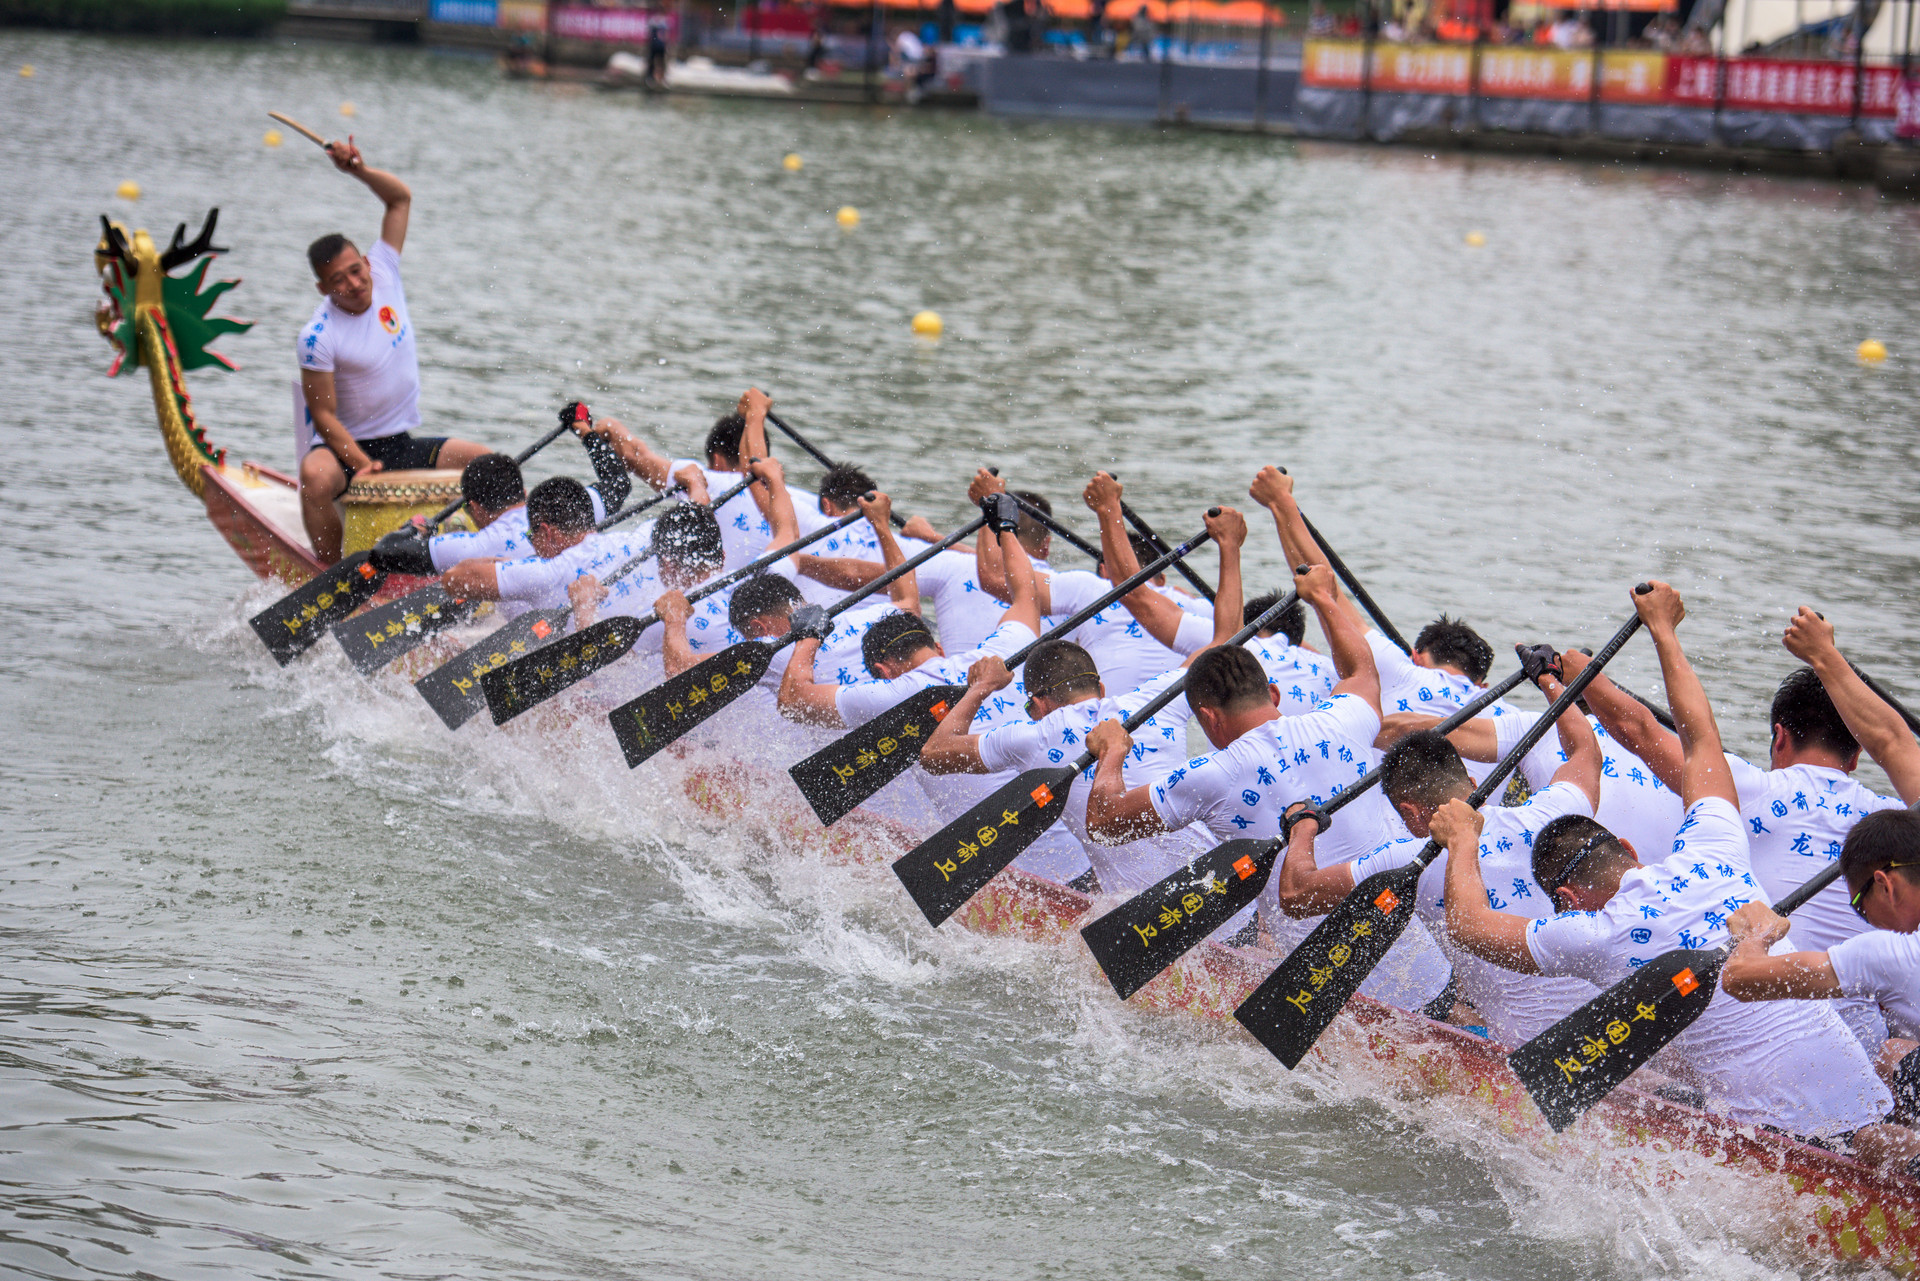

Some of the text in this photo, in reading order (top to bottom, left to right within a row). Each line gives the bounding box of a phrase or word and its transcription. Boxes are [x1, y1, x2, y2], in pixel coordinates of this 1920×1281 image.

[281, 580, 352, 636] 中国前卫
[665, 659, 754, 722] 中国前卫
[831, 722, 921, 786] 中国前卫
[933, 808, 1020, 883] 中国前卫
[1132, 876, 1229, 948] 中国前卫
[1285, 919, 1373, 1015] 中国前卫
[1553, 1001, 1656, 1084] 中国前卫
